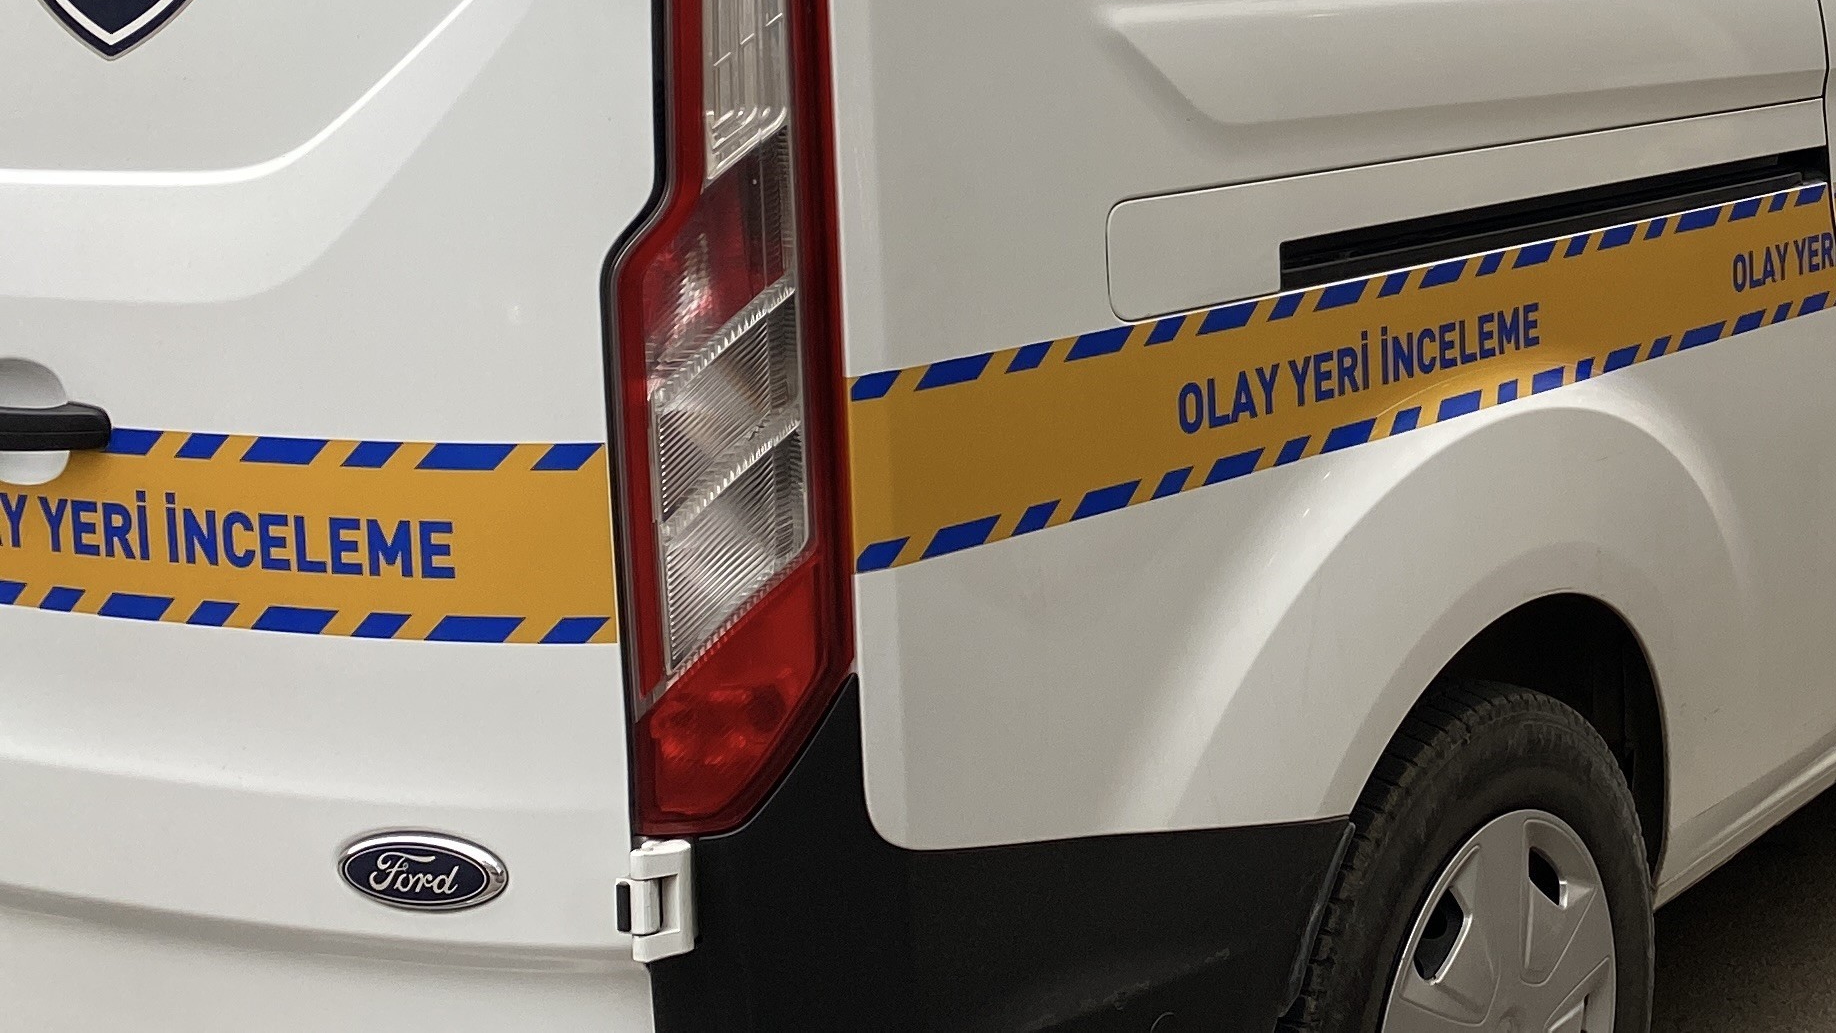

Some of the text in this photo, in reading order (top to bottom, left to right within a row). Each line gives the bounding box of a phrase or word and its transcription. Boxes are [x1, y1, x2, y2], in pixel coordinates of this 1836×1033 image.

[1732, 241, 1789, 292] OLAY
[1177, 303, 1540, 434] OLAY YERİ İNCELEME
[0, 490, 455, 579] Y YERİ İNCELEME
[367, 850, 460, 896] Ford
